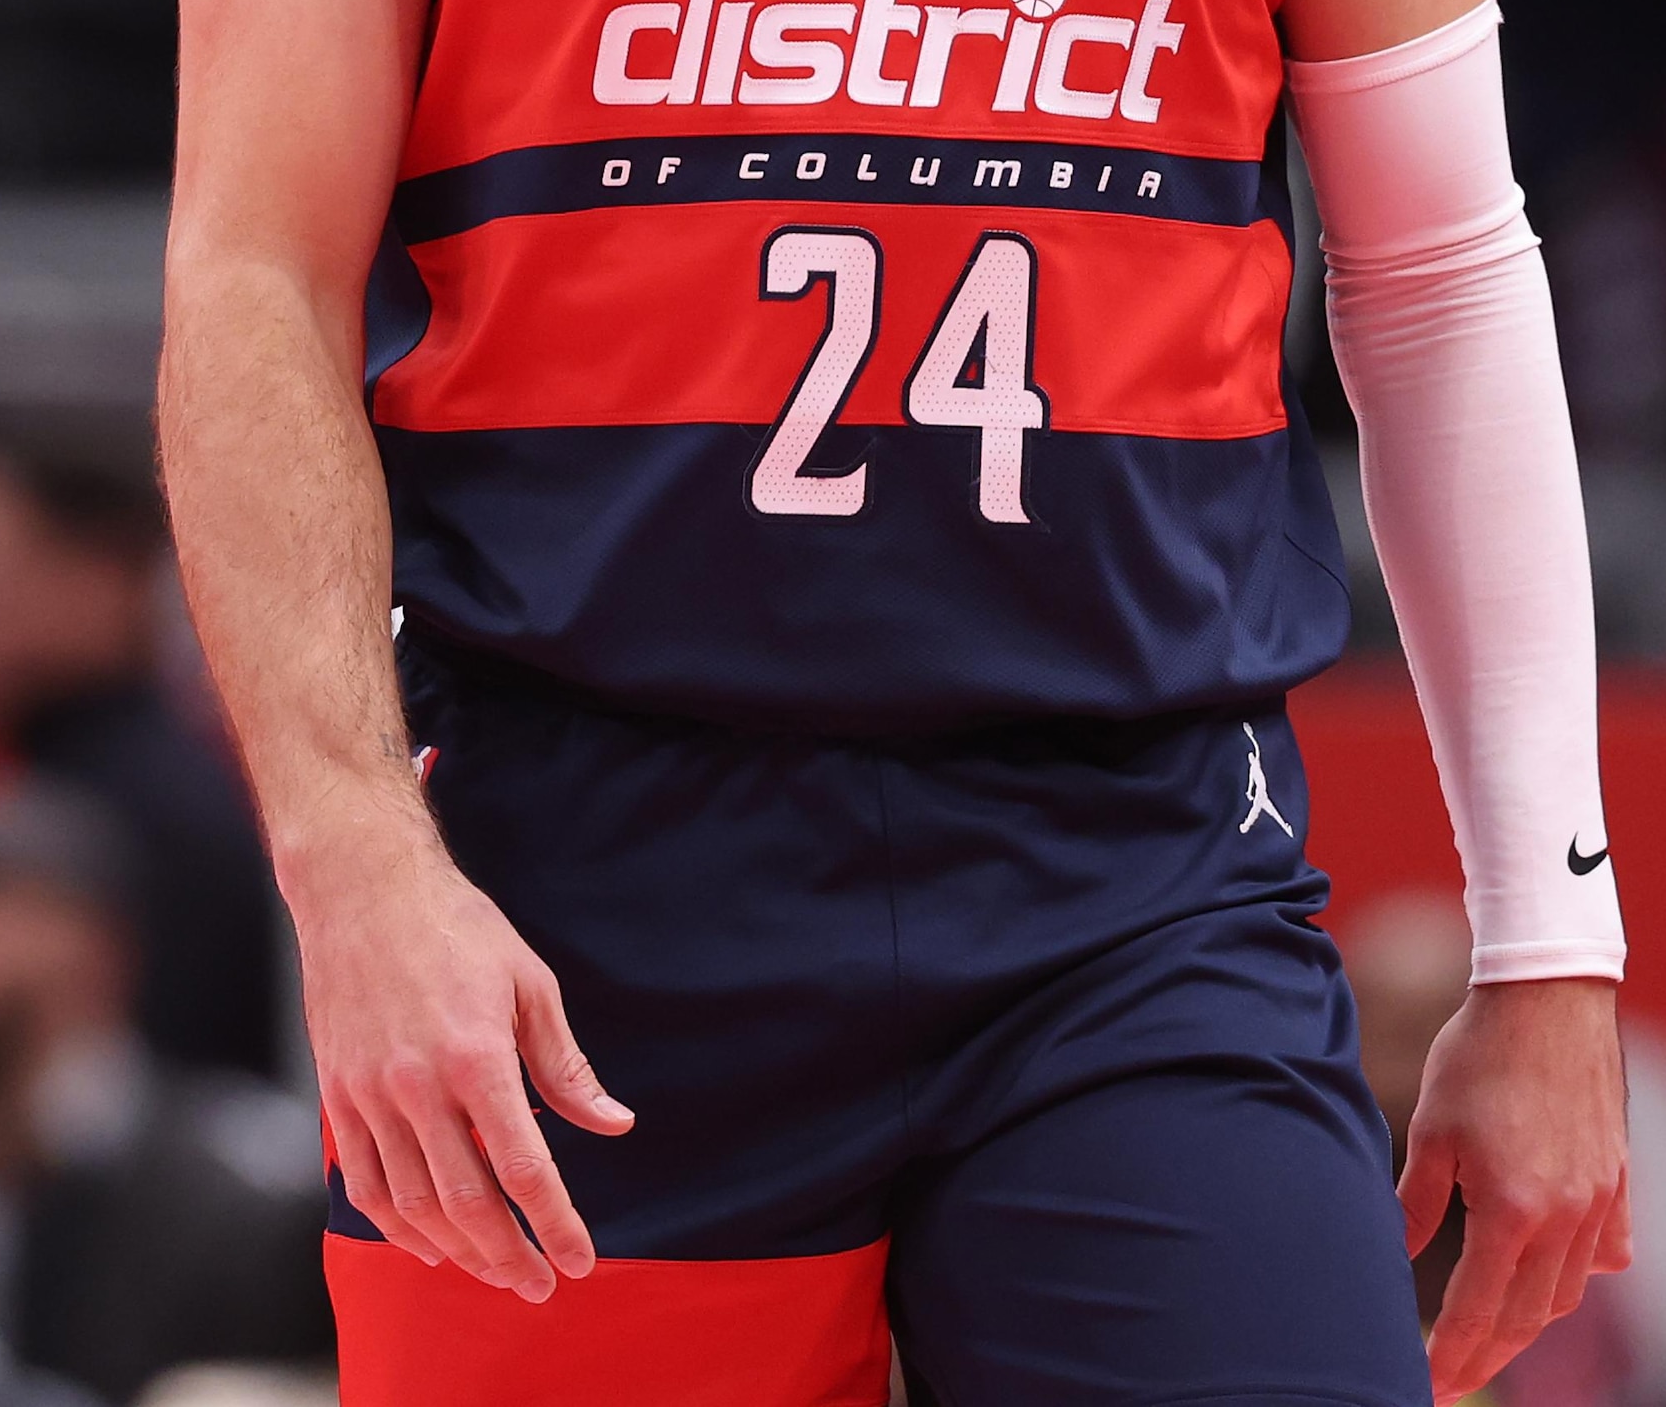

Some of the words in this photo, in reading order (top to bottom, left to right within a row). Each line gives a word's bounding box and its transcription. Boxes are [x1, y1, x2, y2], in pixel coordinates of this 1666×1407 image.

[601, 156, 682, 187] OF
[737, 151, 1163, 199] COLUMBIA
[748, 229, 1046, 526] 24
